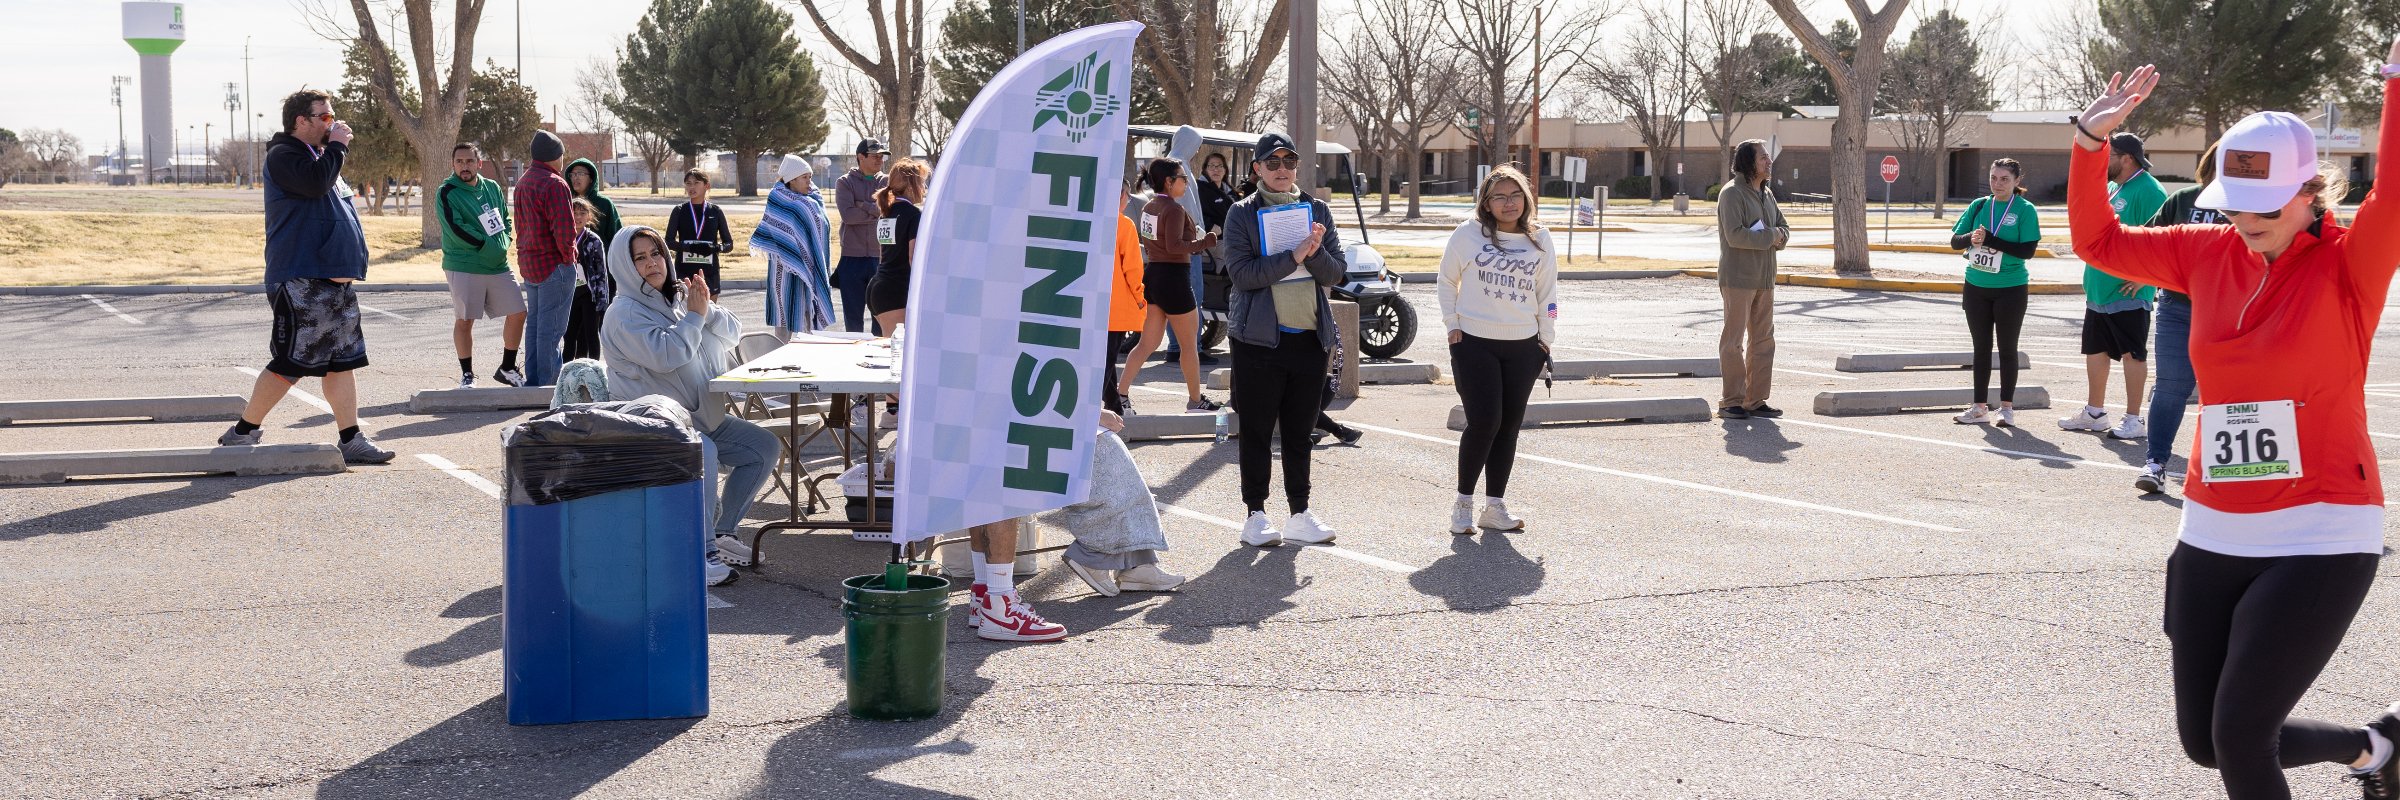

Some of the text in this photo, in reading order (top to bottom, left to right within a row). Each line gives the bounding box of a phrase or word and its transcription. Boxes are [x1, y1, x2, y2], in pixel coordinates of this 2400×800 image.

[1882, 163, 1898, 175] STOP
[2190, 210, 2223, 224] EN
[1475, 243, 1541, 276] Ford
[1974, 253, 1994, 267] 301
[1478, 269, 1534, 292] MOTOR CO.
[1003, 151, 1099, 494] FINISH
[2226, 404, 2259, 414] ENMU
[2215, 428, 2278, 465] 316
[2210, 464, 2288, 476] SPRING BLAST 5K
